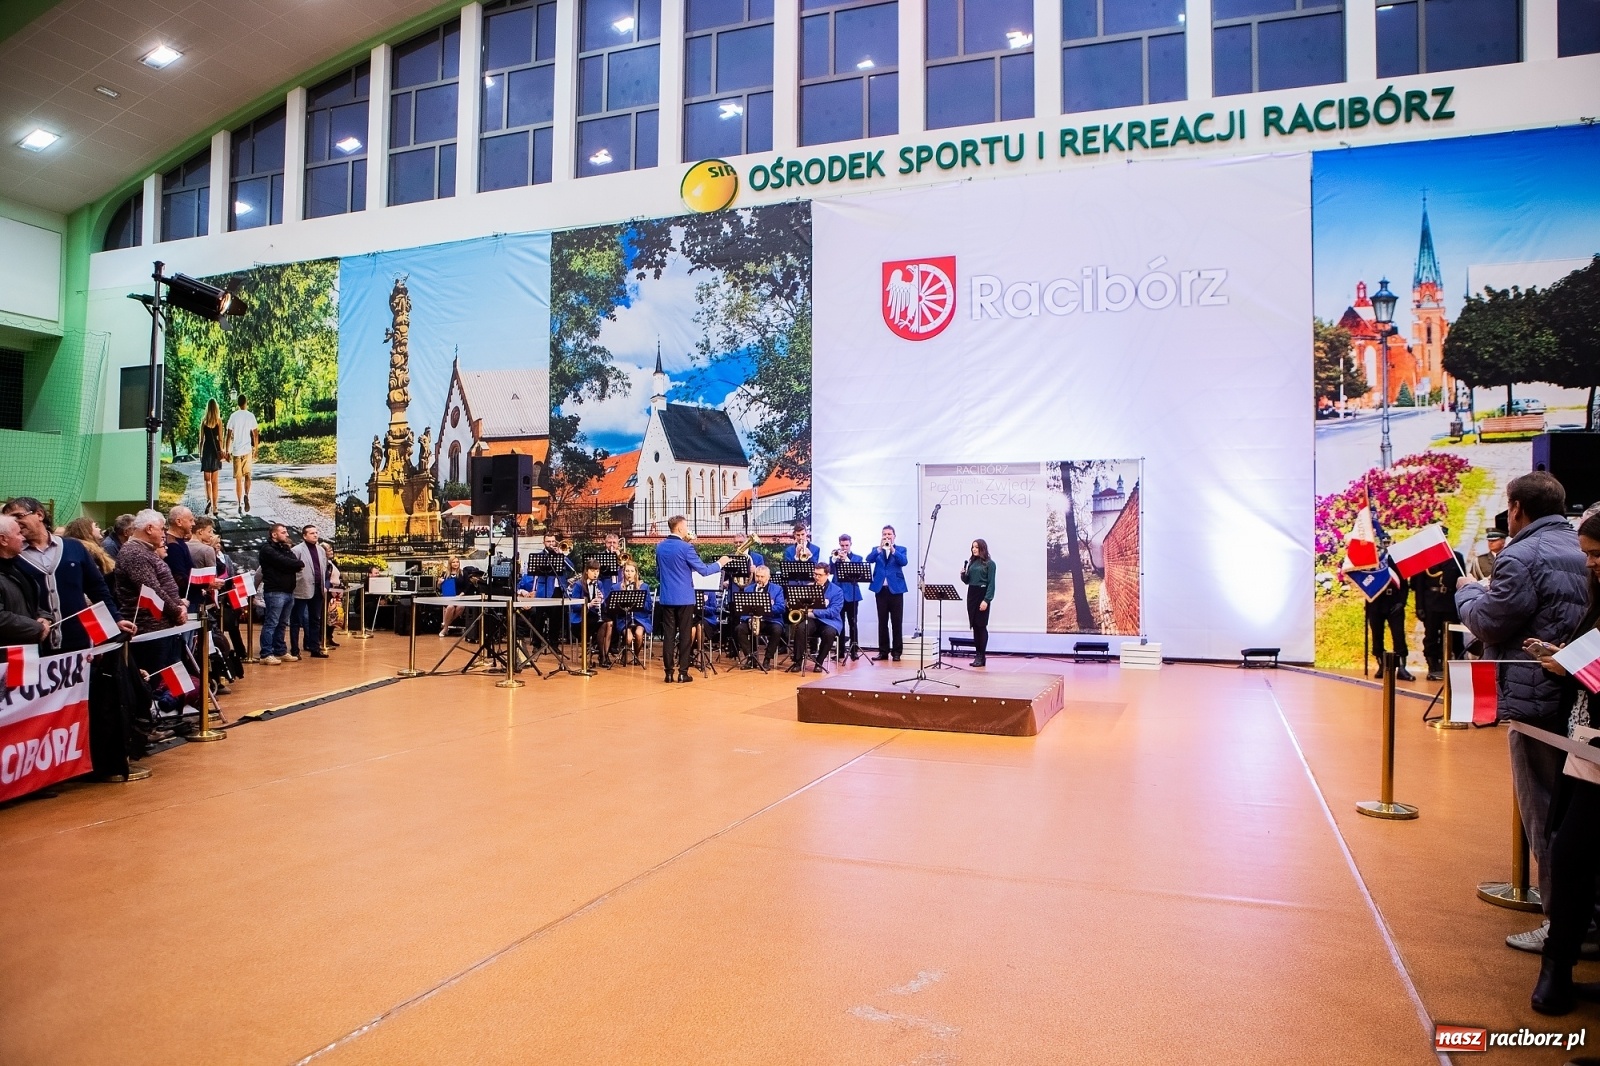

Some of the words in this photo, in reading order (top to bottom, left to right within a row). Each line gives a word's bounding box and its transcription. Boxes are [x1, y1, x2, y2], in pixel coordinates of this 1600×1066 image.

[748, 149, 886, 192] OŚRODEK
[898, 132, 1025, 175] SPORTU
[1038, 131, 1044, 160] I
[1060, 108, 1246, 158] REKREACJI
[1263, 85, 1456, 137] RACIBÓRZ
[970, 255, 1230, 321] Racibórz
[956, 463, 1009, 475] RACIBÓRZ
[930, 481, 963, 493] Pracuj
[938, 489, 1032, 508] Zamieszkaj
